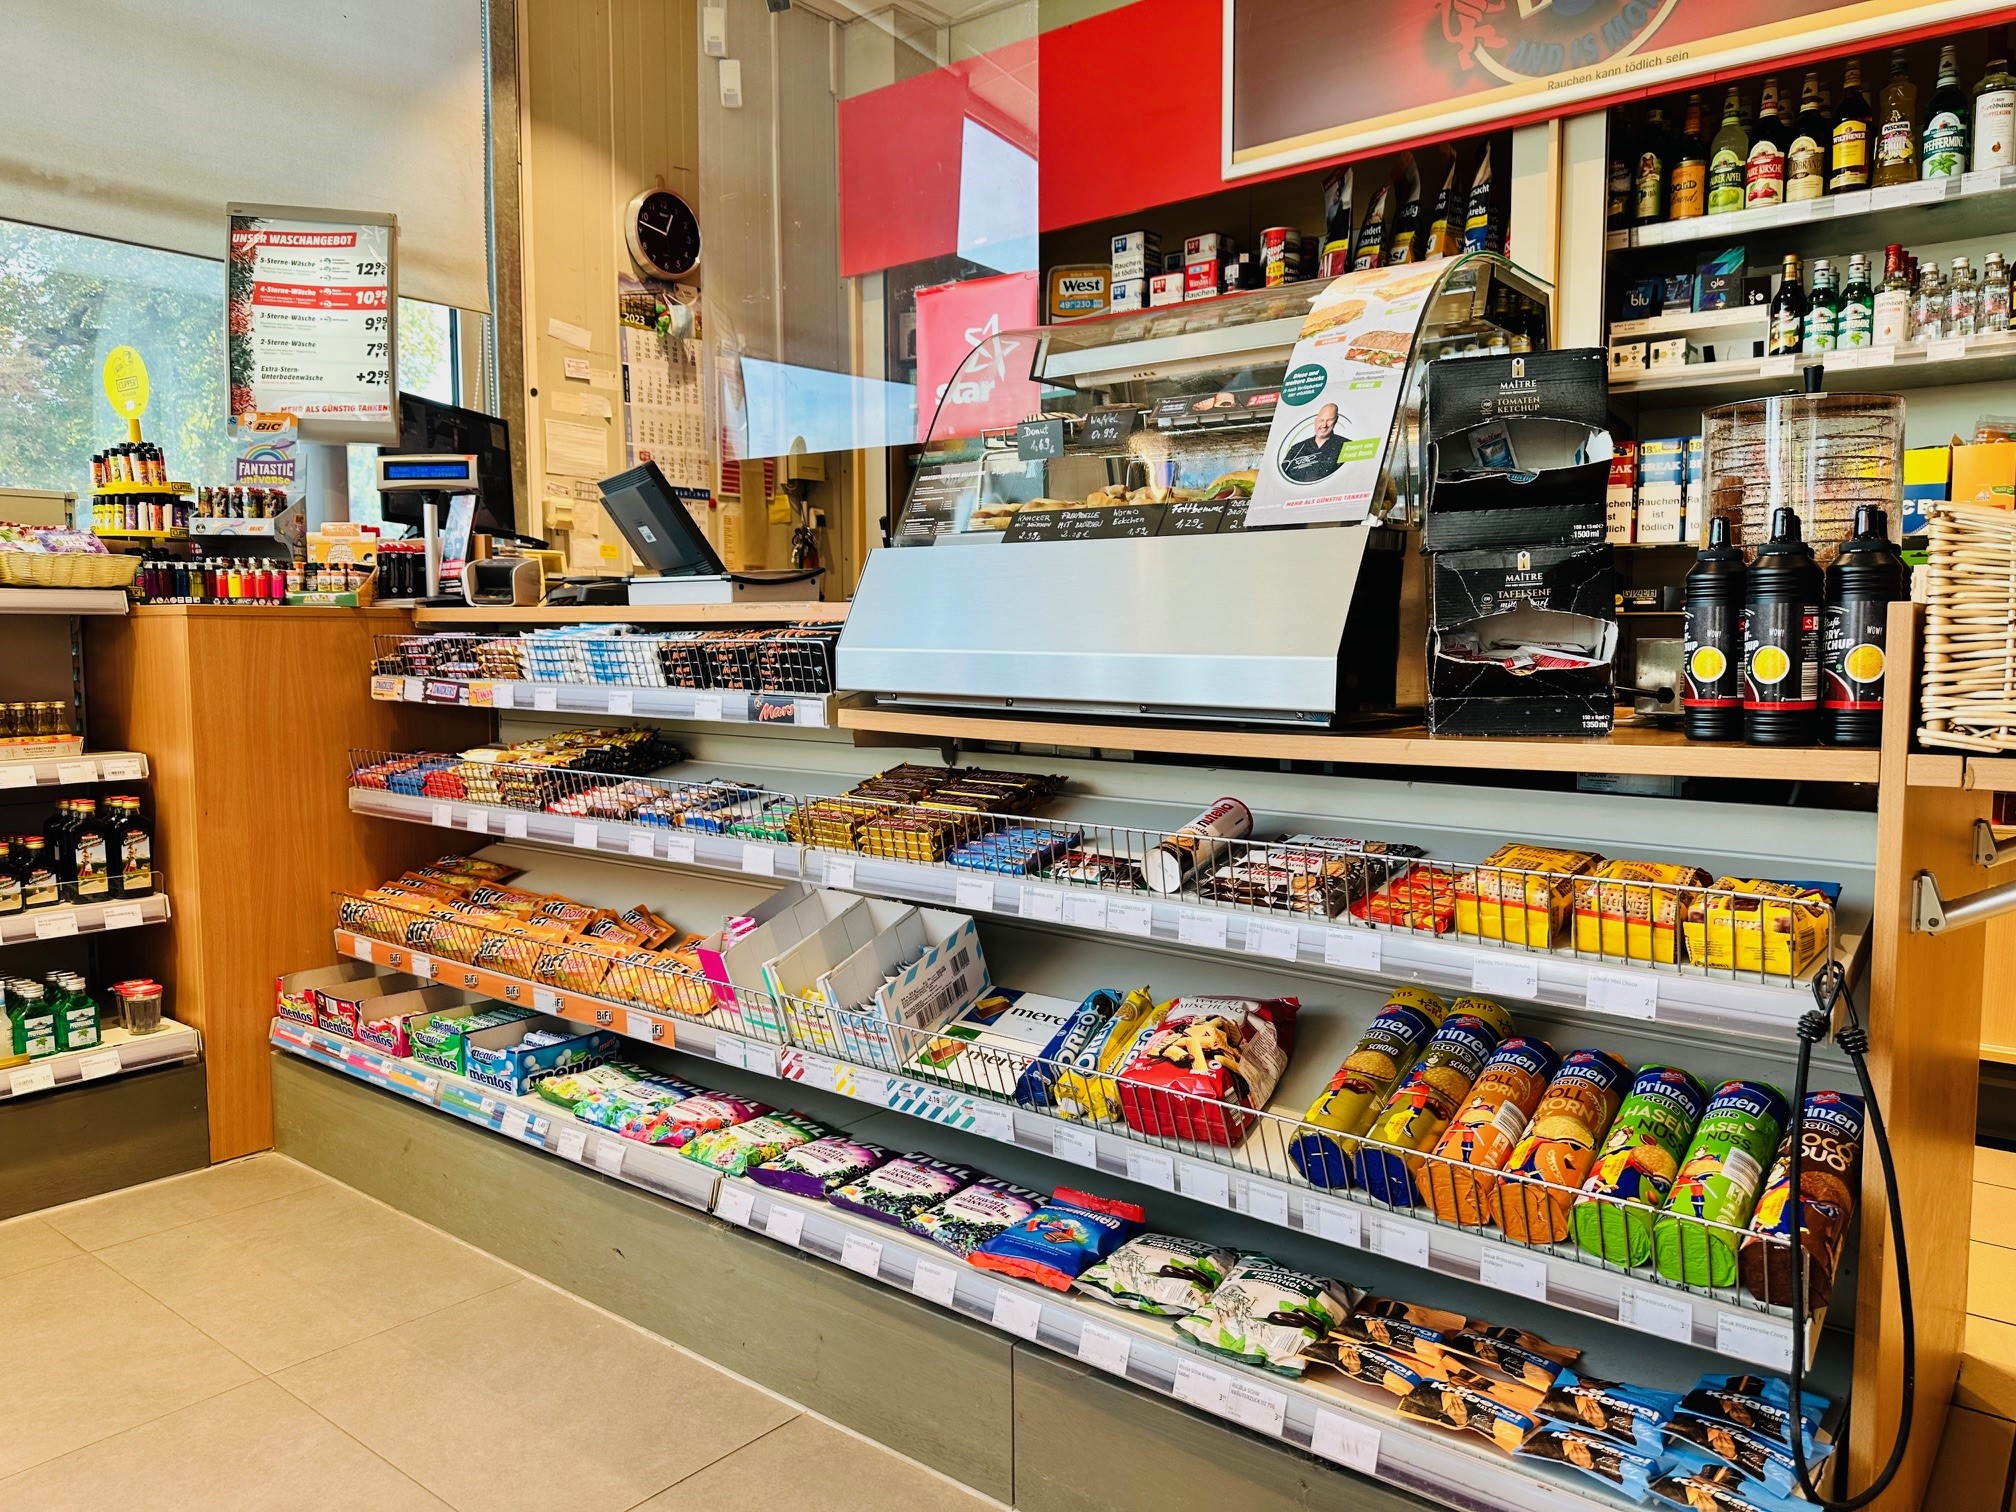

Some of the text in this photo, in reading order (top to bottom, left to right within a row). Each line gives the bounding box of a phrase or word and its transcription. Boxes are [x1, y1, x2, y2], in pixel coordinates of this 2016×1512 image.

[1547, 50, 1689, 91] Rauchen kann tödlich sein
[1923, 136, 1964, 153] PFEFFERMINZ
[1759, 164, 1783, 173] KIRSCHE
[1725, 172, 1742, 182] APFEL
[641, 212, 649, 221] 10
[232, 233, 353, 246] UNSER WASCHANGEBOT
[260, 257, 316, 268] 5-Sterne-Wäsche
[1114, 259, 1142, 270] Rauchen
[1121, 267, 1143, 277] tödlich
[1062, 278, 1100, 293] West
[1710, 278, 1725, 289] glo
[260, 286, 317, 297] 4-Sterne-Wäsche
[1185, 289, 1215, 299] Rauchen
[1630, 293, 1649, 306] blu
[260, 312, 316, 322] 3-Sterne-Wäsche
[624, 312, 646, 325] 2023
[260, 338, 316, 348] 2-Sterne-Wäsche
[261, 365, 301, 373] Extra-Stern-
[261, 373, 324, 382] Unterbodenwäsche
[1499, 379, 1537, 390] MAÎTRE
[935, 379, 996, 406] star
[1497, 396, 1540, 406] TOMATEN
[305, 405, 320, 413] ALS
[321, 404, 357, 413] GÜNSTIG
[1497, 404, 1540, 414] KETCHUP
[1090, 413, 1119, 426] Waffel
[1021, 426, 1049, 438] Donut
[238, 462, 294, 476] FANTASTIC
[1640, 461, 1681, 472] BREAK
[1285, 492, 1371, 508] MEHR ALS GÜNSTIG TANKEN!
[1639, 498, 1680, 507] Rauchen
[1171, 502, 1224, 514] Fettbemme
[1652, 510, 1664, 518] ist
[1018, 514, 1051, 522] KNACKER
[1057, 520, 1074, 529] MIT
[1641, 523, 1674, 532] tödlich
[1505, 572, 1544, 582] MAÎTRE
[1496, 588, 1552, 599] TAFELSENF
[1706, 629, 1722, 639] WOW!
[1768, 627, 1785, 638] WOW!
[1866, 625, 1883, 636] WOW!
[425, 682, 455, 696] 2 SNICKERS
[758, 702, 795, 721] Mars
[1197, 800, 1233, 828] nutella
[1311, 834, 1362, 846] nutella
[1267, 850, 1320, 866] nutella
[1517, 851, 1554, 862] MINIS
[1237, 868, 1289, 879] nutella
[1623, 861, 1664, 878] MINIS
[1487, 882, 1524, 896] LEIBNIZ
[1606, 896, 1644, 910] LEIBNIZ
[562, 907, 588, 920] Roll
[389, 953, 402, 964] BiFi
[464, 973, 478, 985] BiFi
[505, 985, 520, 997] BiFi
[279, 1005, 313, 1024] mentos
[596, 1009, 613, 1023] BiFi
[320, 1018, 354, 1037] mentos
[432, 1019, 461, 1033] mentos
[360, 1027, 393, 1048] mentos
[1055, 1013, 1099, 1069] OREO
[1074, 1019, 1116, 1077] OREO
[1367, 1043, 1399, 1056] SCHOKO
[1432, 1042, 1472, 1063] Rolle
[415, 1048, 458, 1071] mentos
[1448, 1059, 1476, 1081] SCHOKO
[1485, 1065, 1516, 1076] Rolle
[469, 1066, 513, 1092] mentos
[1552, 1077, 1588, 1090] Rolle
[1478, 1080, 1520, 1101] KORN
[1634, 1079, 1697, 1115] Prinzen
[1540, 1098, 1594, 1123] KORN
[1642, 1094, 1681, 1115] Rolle
[1704, 1109, 1740, 1121] Rolle
[1624, 1104, 1683, 1140] HASEL
[1698, 1123, 1743, 1136] HASEL
[903, 1151, 972, 1180] VIVIL
[879, 1168, 933, 1190] JOHANNISBEERE
[892, 1166, 930, 1182] SCHWARZE
[979, 1176, 1051, 1206] VIVIL
[968, 1192, 1008, 1209] SCHWARZE
[955, 1195, 1012, 1220] JOHANNISBEERE
[1149, 1242, 1192, 1255] MENTHOL
[1251, 1270, 1315, 1291] EUKALYPTUS
[1257, 1274, 1301, 1291] MENTHOL
[1354, 1313, 1438, 1341] Krügerol
[1462, 1332, 1551, 1367] Krügerol
[1430, 1381, 1526, 1423] Krügerol
[1562, 1385, 1660, 1422] Krügerol
[1550, 1430, 1651, 1467] Krügerol
[1695, 1418, 1795, 1468] Krügerol
